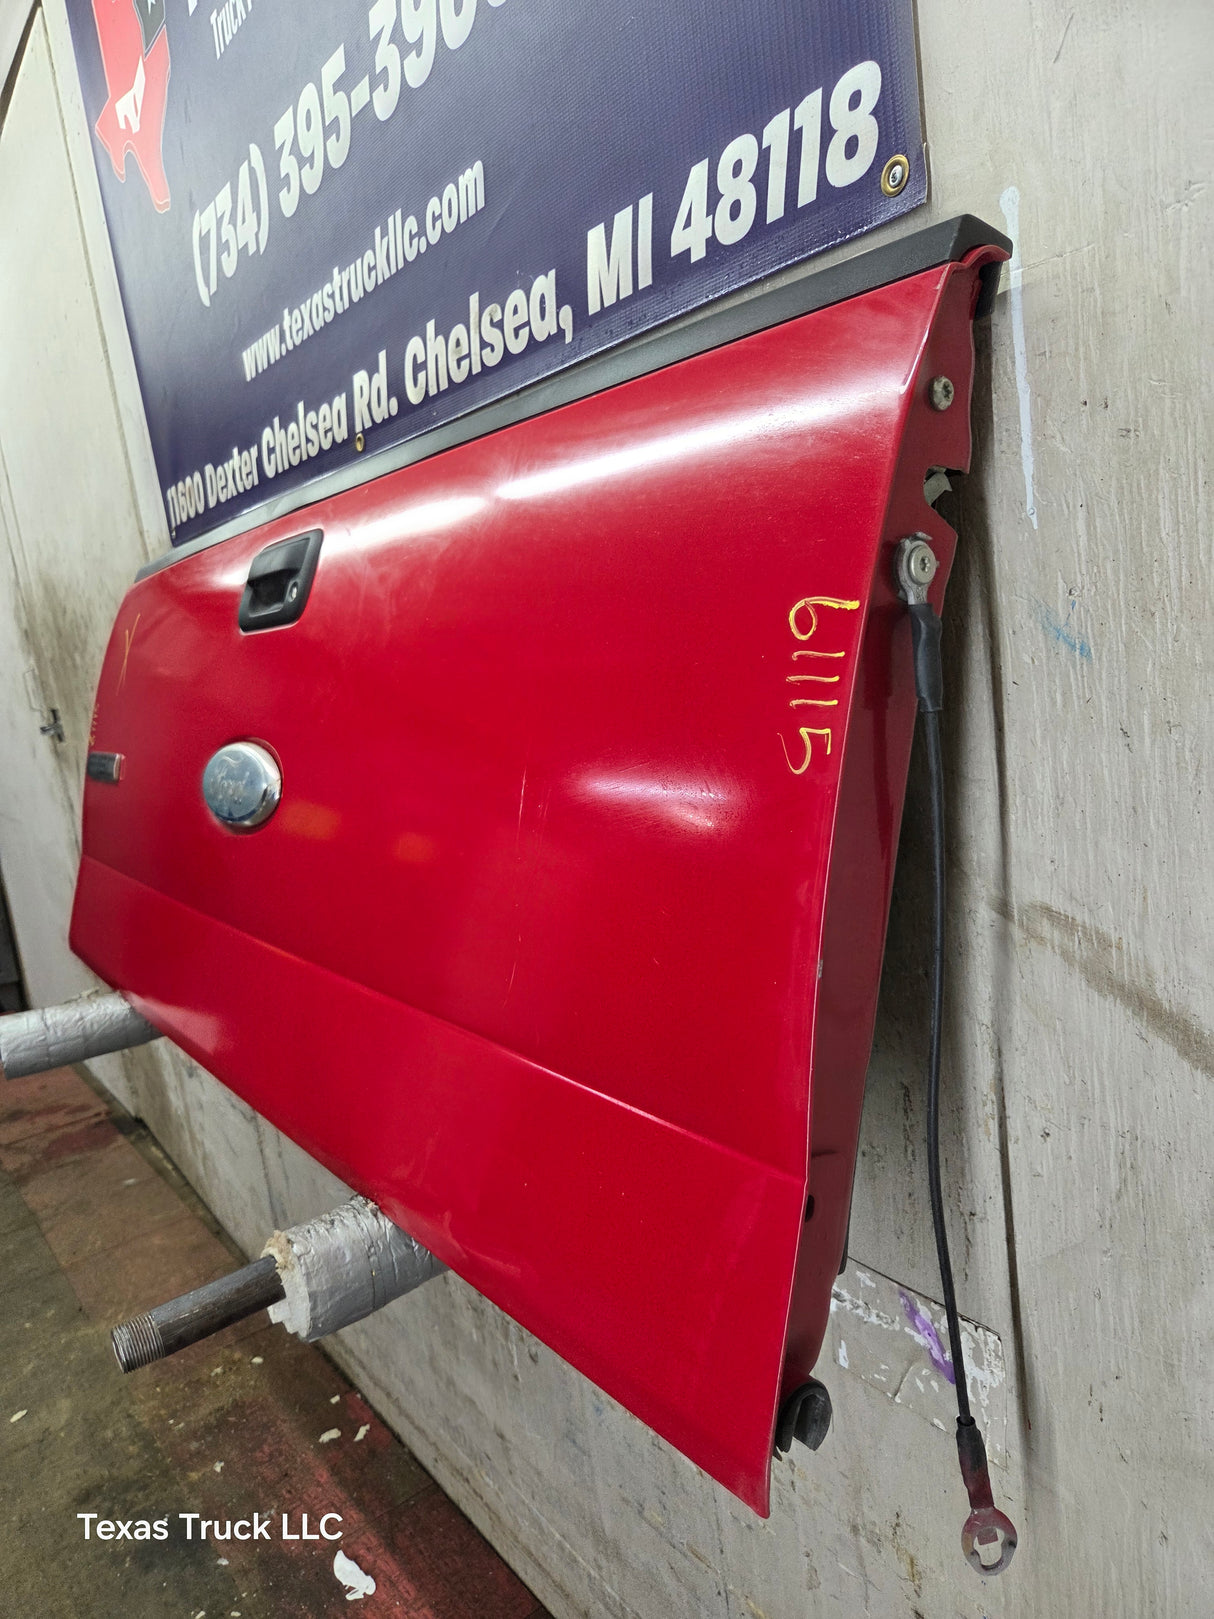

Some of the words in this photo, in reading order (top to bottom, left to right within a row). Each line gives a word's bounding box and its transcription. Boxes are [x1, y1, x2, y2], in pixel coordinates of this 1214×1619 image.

[192, 143, 269, 307] (734)
[273, 0, 506, 218] 395-39
[242, 160, 486, 382] www.texastruckllc.com
[166, 470, 205, 530] 11600
[204, 444, 259, 509] Dexter
[261, 392, 348, 479] Chelsea
[352, 349, 399, 434] Rd.
[404, 269, 573, 405] Chelsea,
[586, 192, 653, 316] MI
[670, 60, 882, 264] 48118
[777, 596, 861, 774] 61115
